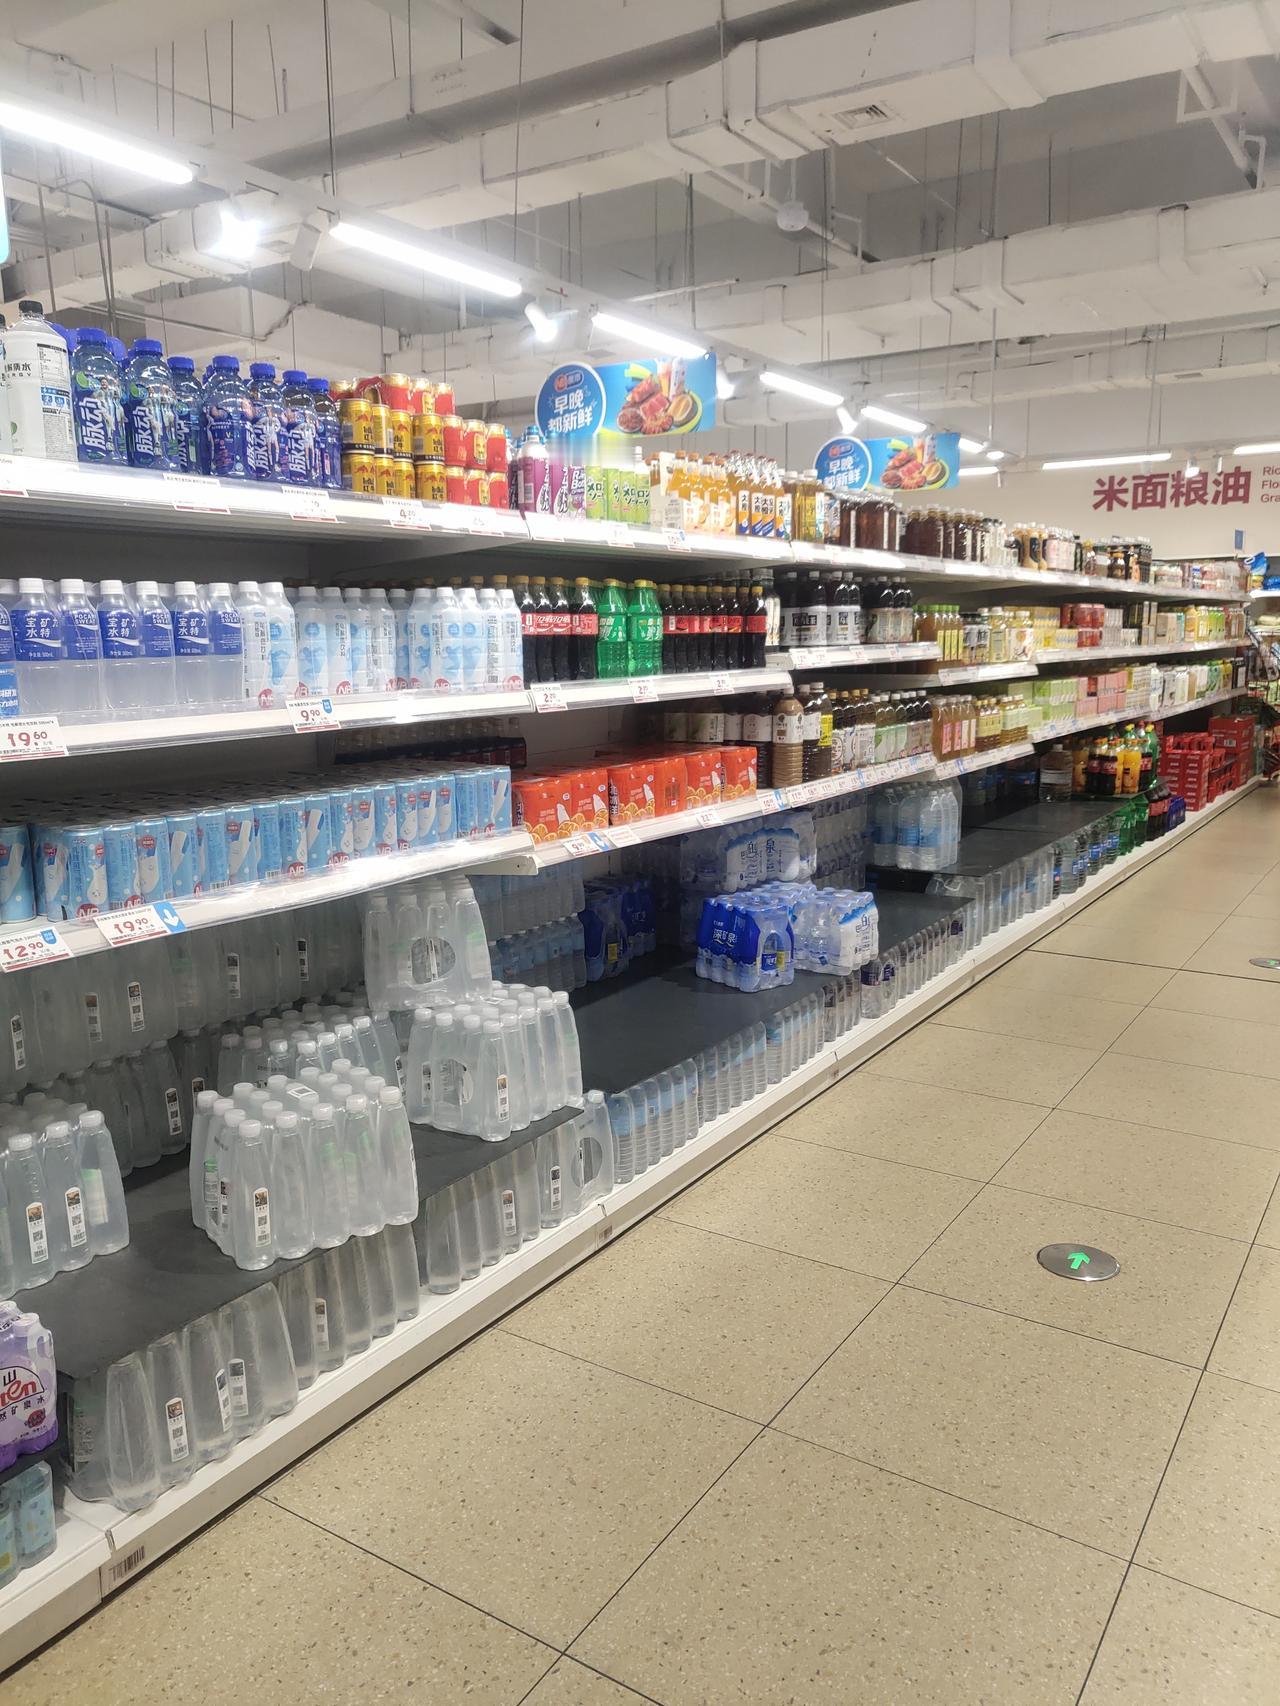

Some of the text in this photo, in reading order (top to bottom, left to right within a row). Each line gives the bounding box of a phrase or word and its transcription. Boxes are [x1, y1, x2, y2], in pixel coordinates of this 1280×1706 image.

[554, 390, 584, 415] 早晚
[548, 408, 593, 433] 都新鲜
[828, 458, 855, 475] 早晚
[823, 471, 862, 491] 都新鲜
[1092, 466, 1252, 512] 米面粮油
[26, 629, 51, 638] 水特
[107, 628, 130, 638] 水特
[178, 628, 199, 637] 水特
[113, 917, 149, 935] 19.90
[3, 941, 44, 960] 12.90
[3, 1370, 17, 1386] 山
